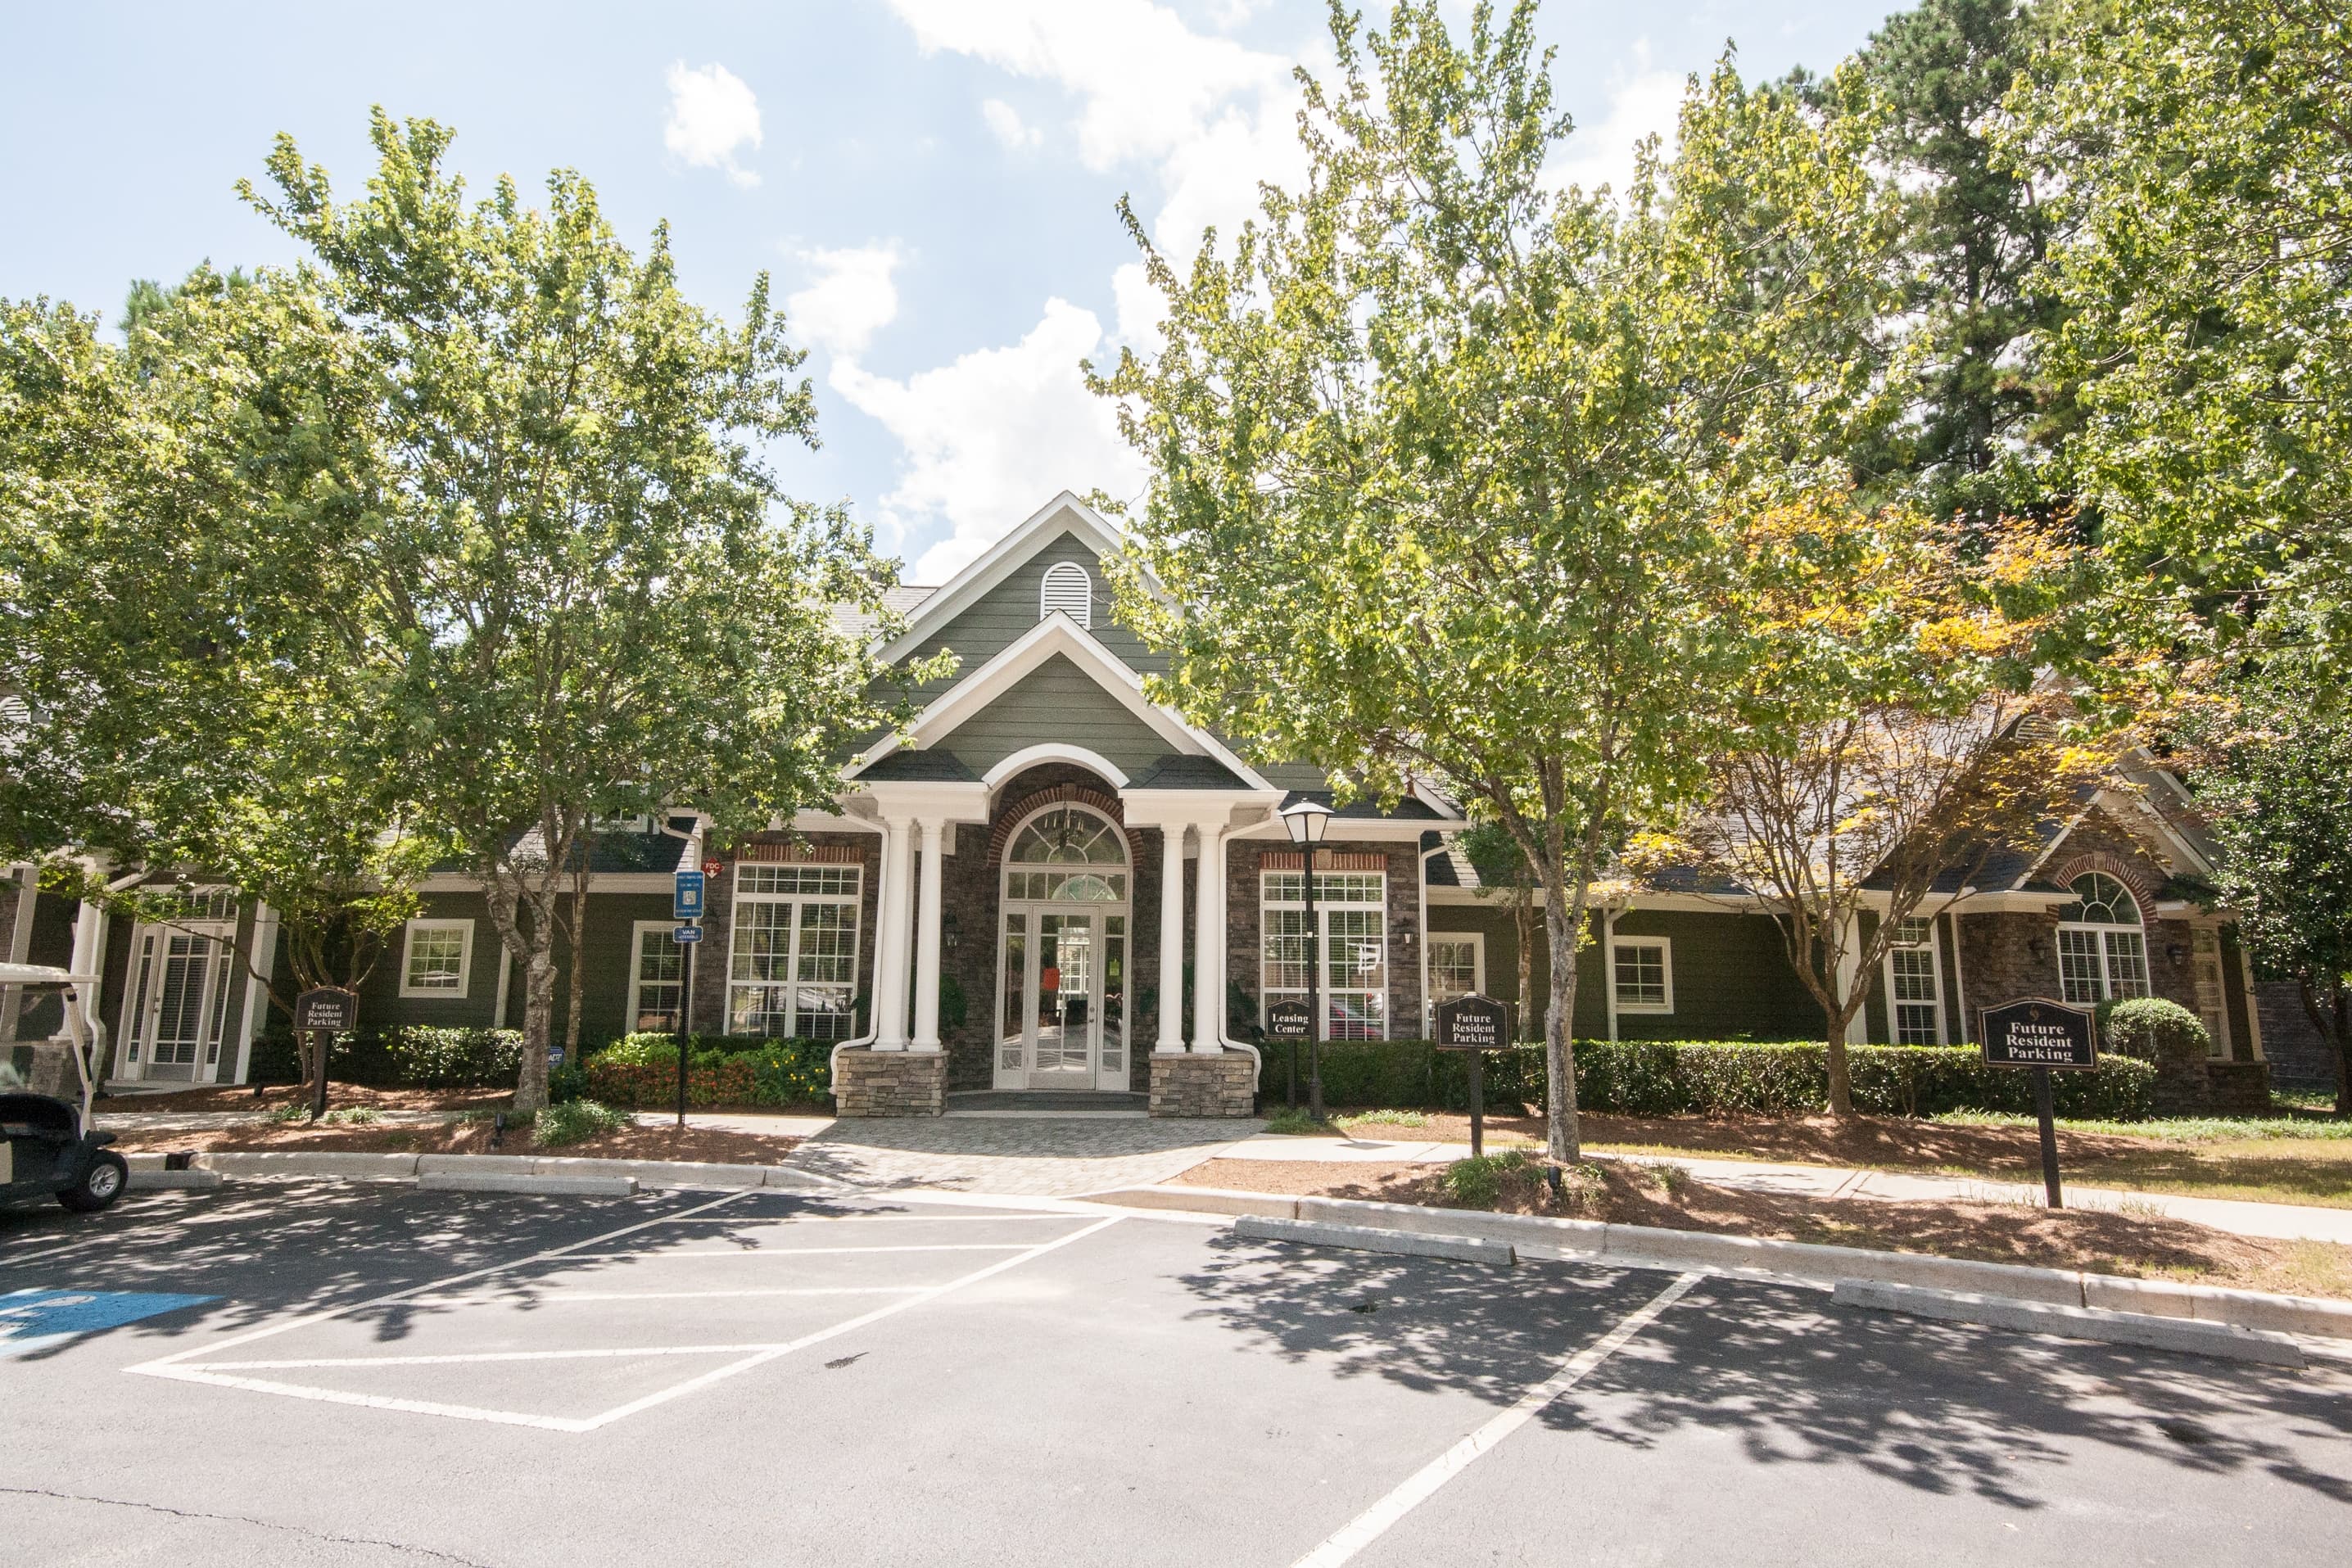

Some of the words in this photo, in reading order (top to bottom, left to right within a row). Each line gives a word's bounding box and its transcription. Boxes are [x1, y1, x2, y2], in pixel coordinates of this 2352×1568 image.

[312, 1001, 341, 1010] Future
[308, 1010, 342, 1018] Resident
[1273, 1013, 1309, 1025] Leasing
[1456, 1013, 1491, 1023] Future
[308, 1018, 341, 1027] Parking
[1275, 1023, 1305, 1033] Center
[1452, 1023, 1495, 1033] Resident
[2011, 1022, 2065, 1034] Future
[1453, 1033, 1495, 1045] Parking
[2006, 1034, 2073, 1047] Resident
[2008, 1047, 2074, 1063] Parking
